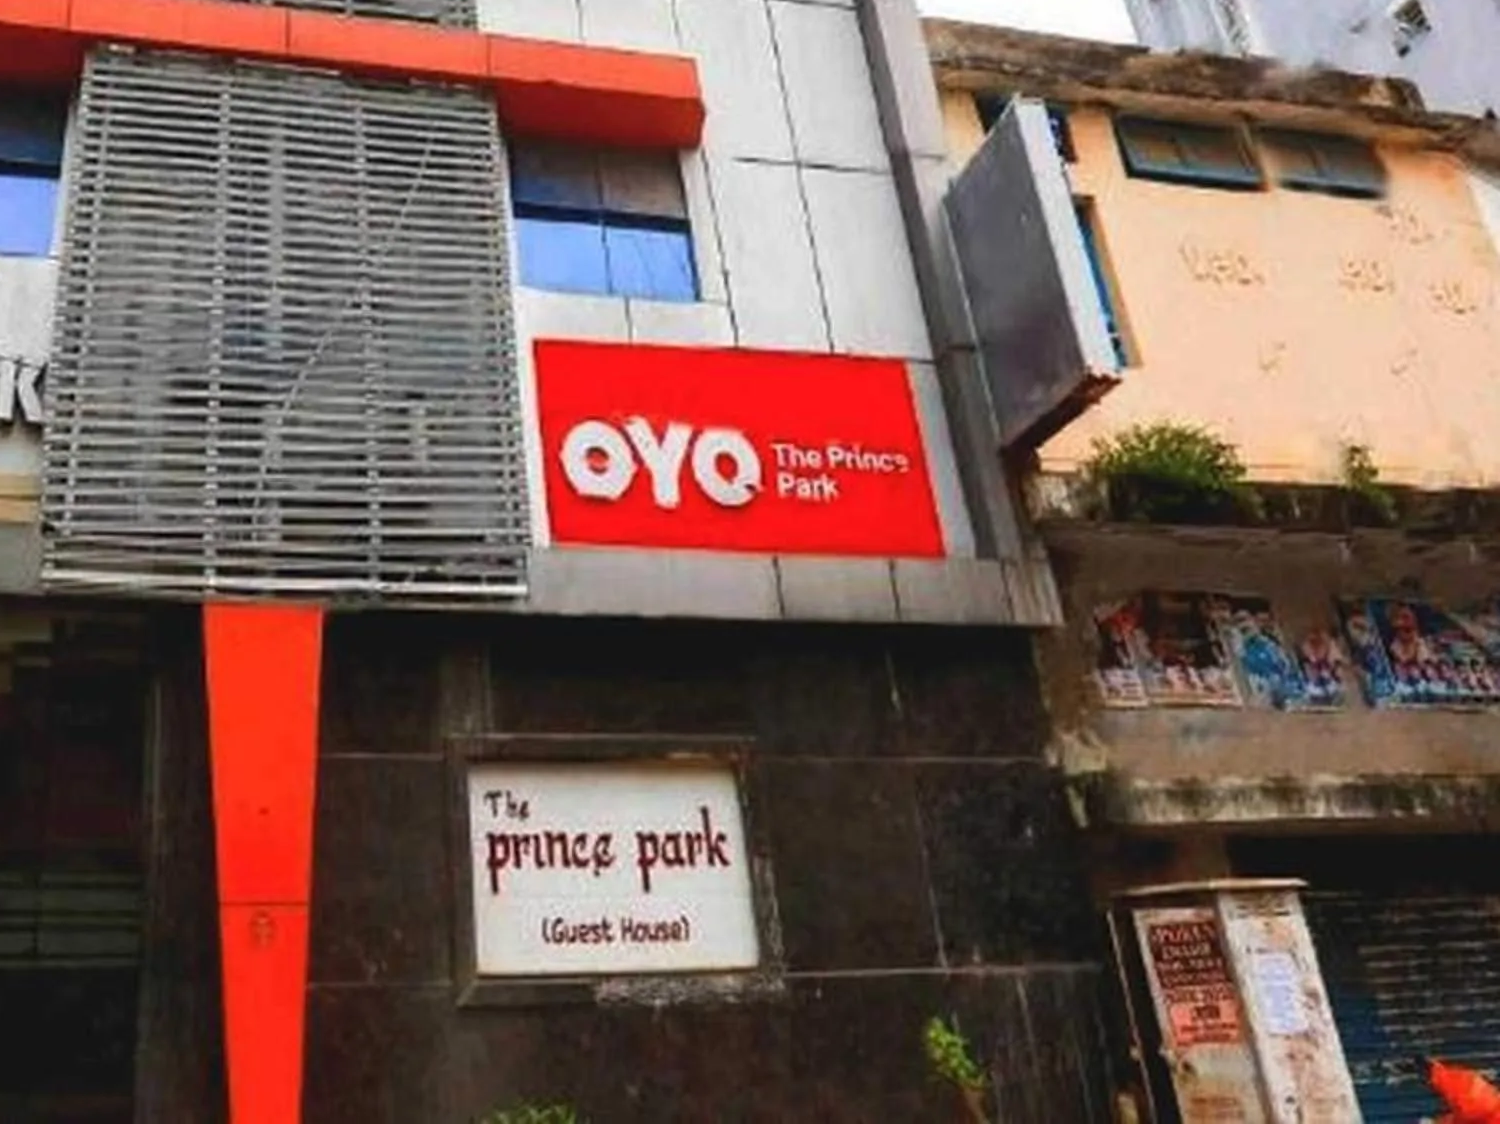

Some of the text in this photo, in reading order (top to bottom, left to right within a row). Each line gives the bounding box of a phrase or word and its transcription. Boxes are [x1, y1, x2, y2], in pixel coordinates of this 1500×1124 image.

[560, 414, 762, 510] OYO
[770, 442, 910, 474] The Prince
[777, 472, 840, 502] Park
[483, 789, 531, 822] The
[486, 806, 730, 895] prince park
[541, 916, 690, 945] (Guest House)
